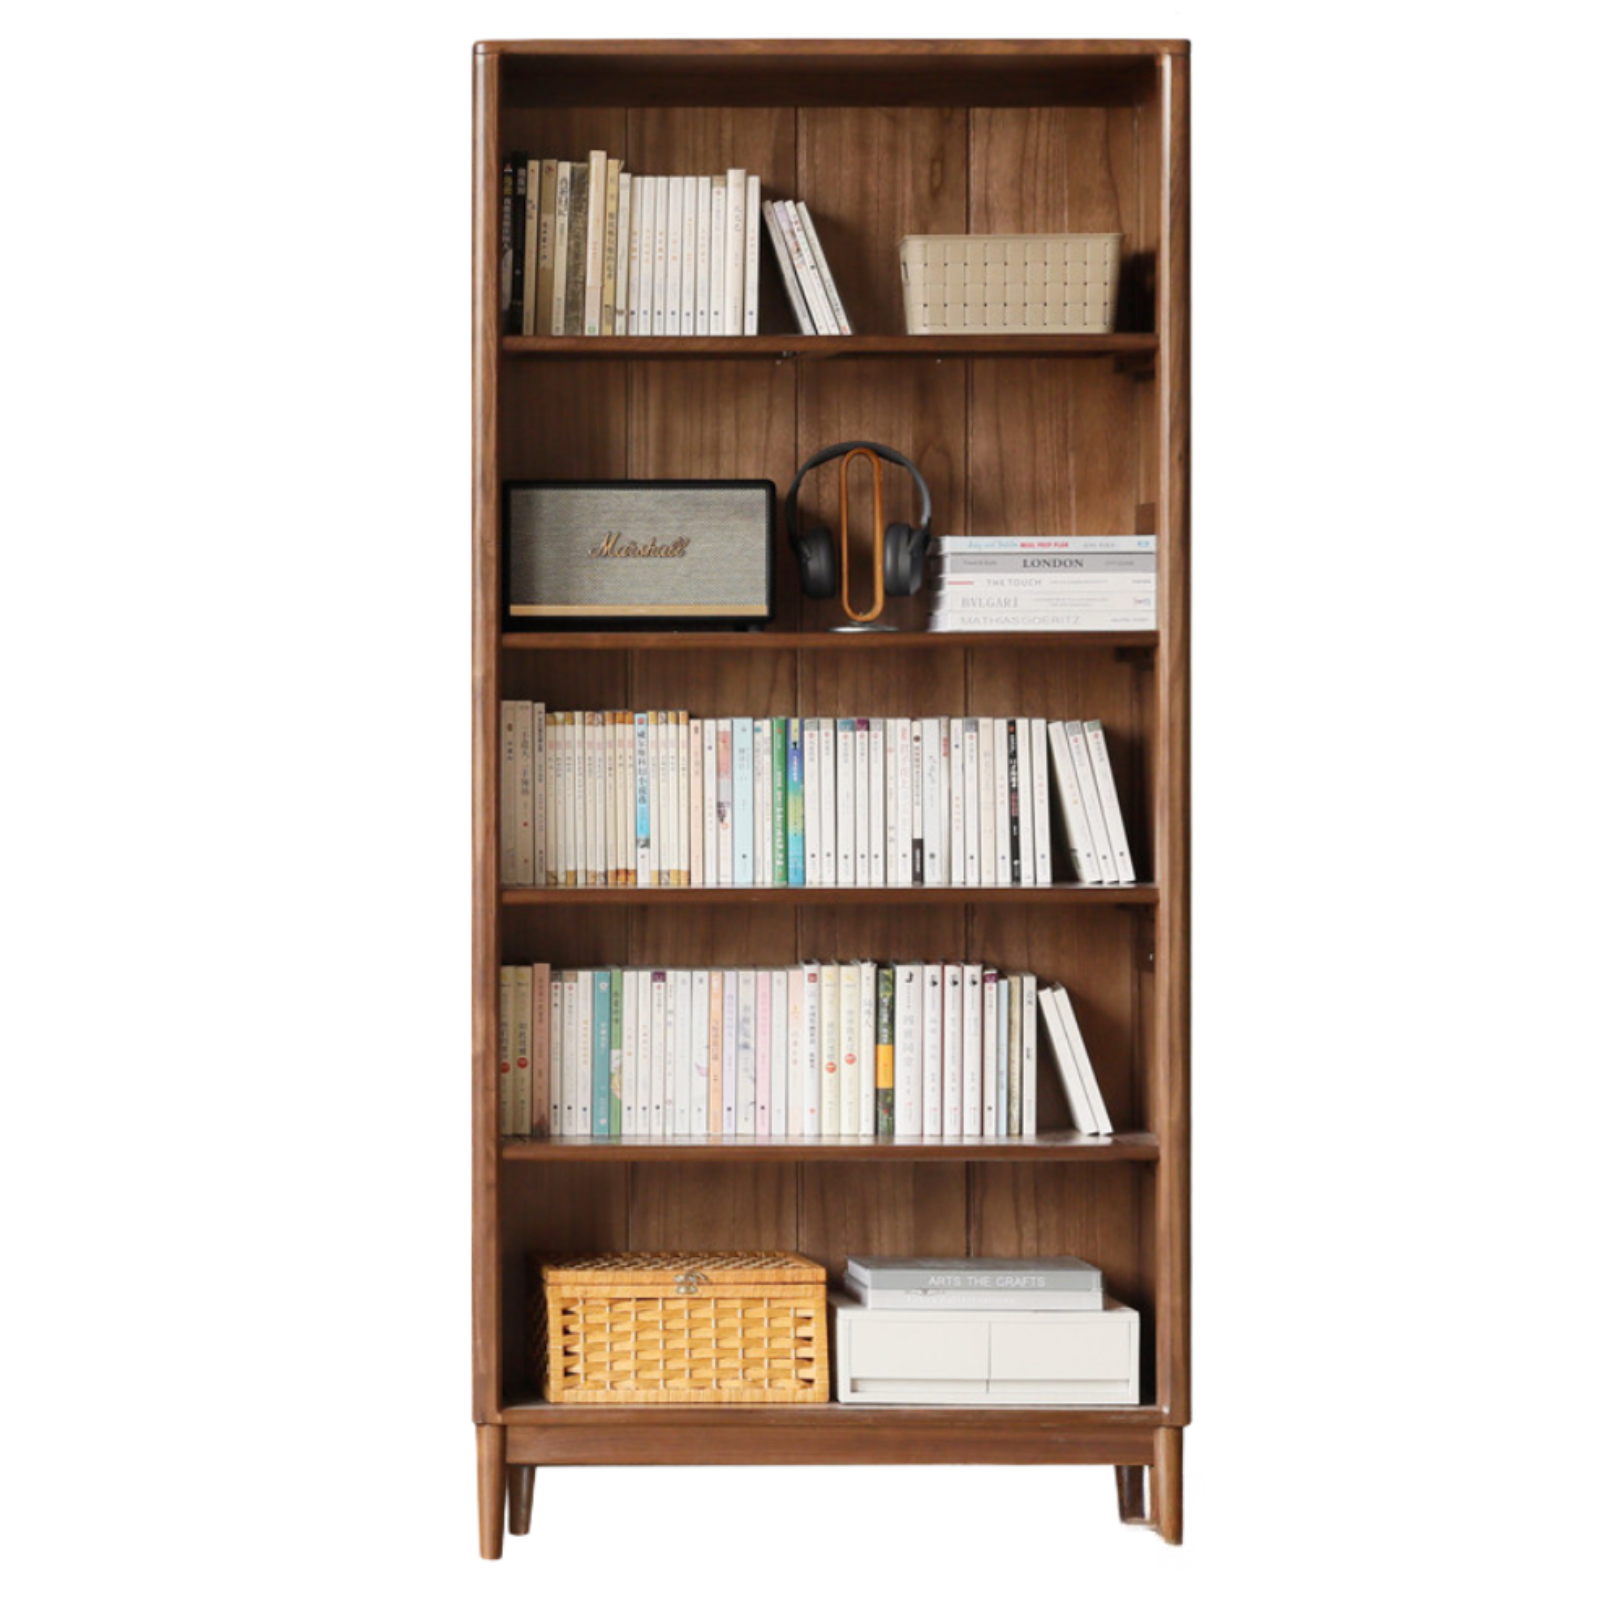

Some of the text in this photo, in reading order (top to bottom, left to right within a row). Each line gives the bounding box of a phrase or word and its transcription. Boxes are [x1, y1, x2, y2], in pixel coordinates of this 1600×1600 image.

[588, 530, 691, 558] Marshall
[1022, 558, 1084, 568] LONDON
[986, 578, 1005, 587] THE
[1007, 578, 1042, 587] TOUCH
[961, 597, 1019, 609] BVLGARI
[928, 1275, 962, 1287] ARTS
[966, 1275, 992, 1287] THE
